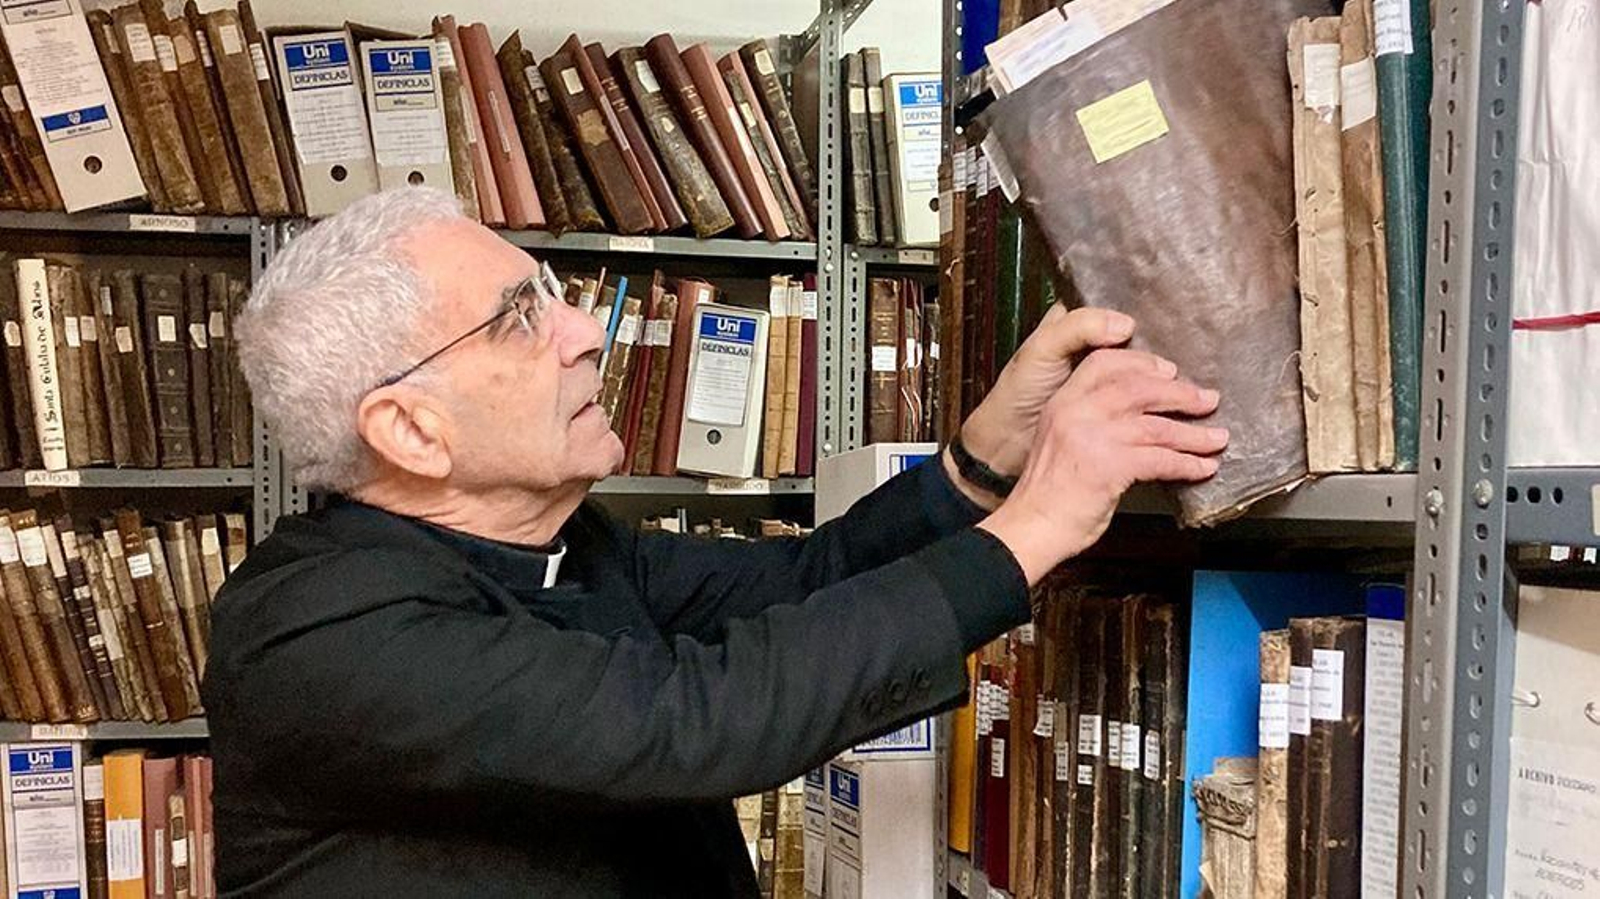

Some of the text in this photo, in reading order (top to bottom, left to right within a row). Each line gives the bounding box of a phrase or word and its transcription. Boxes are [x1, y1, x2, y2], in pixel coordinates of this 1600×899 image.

[302, 43, 329, 59] Uni
[387, 50, 414, 65] Uni
[294, 70, 348, 84] DEFINICLAS
[377, 78, 430, 89] DEFINICLAS
[914, 83, 938, 99] Uni
[717, 317, 741, 332] Uni
[28, 750, 54, 765] Uni
[15, 776, 70, 788] DEFINICLAS
